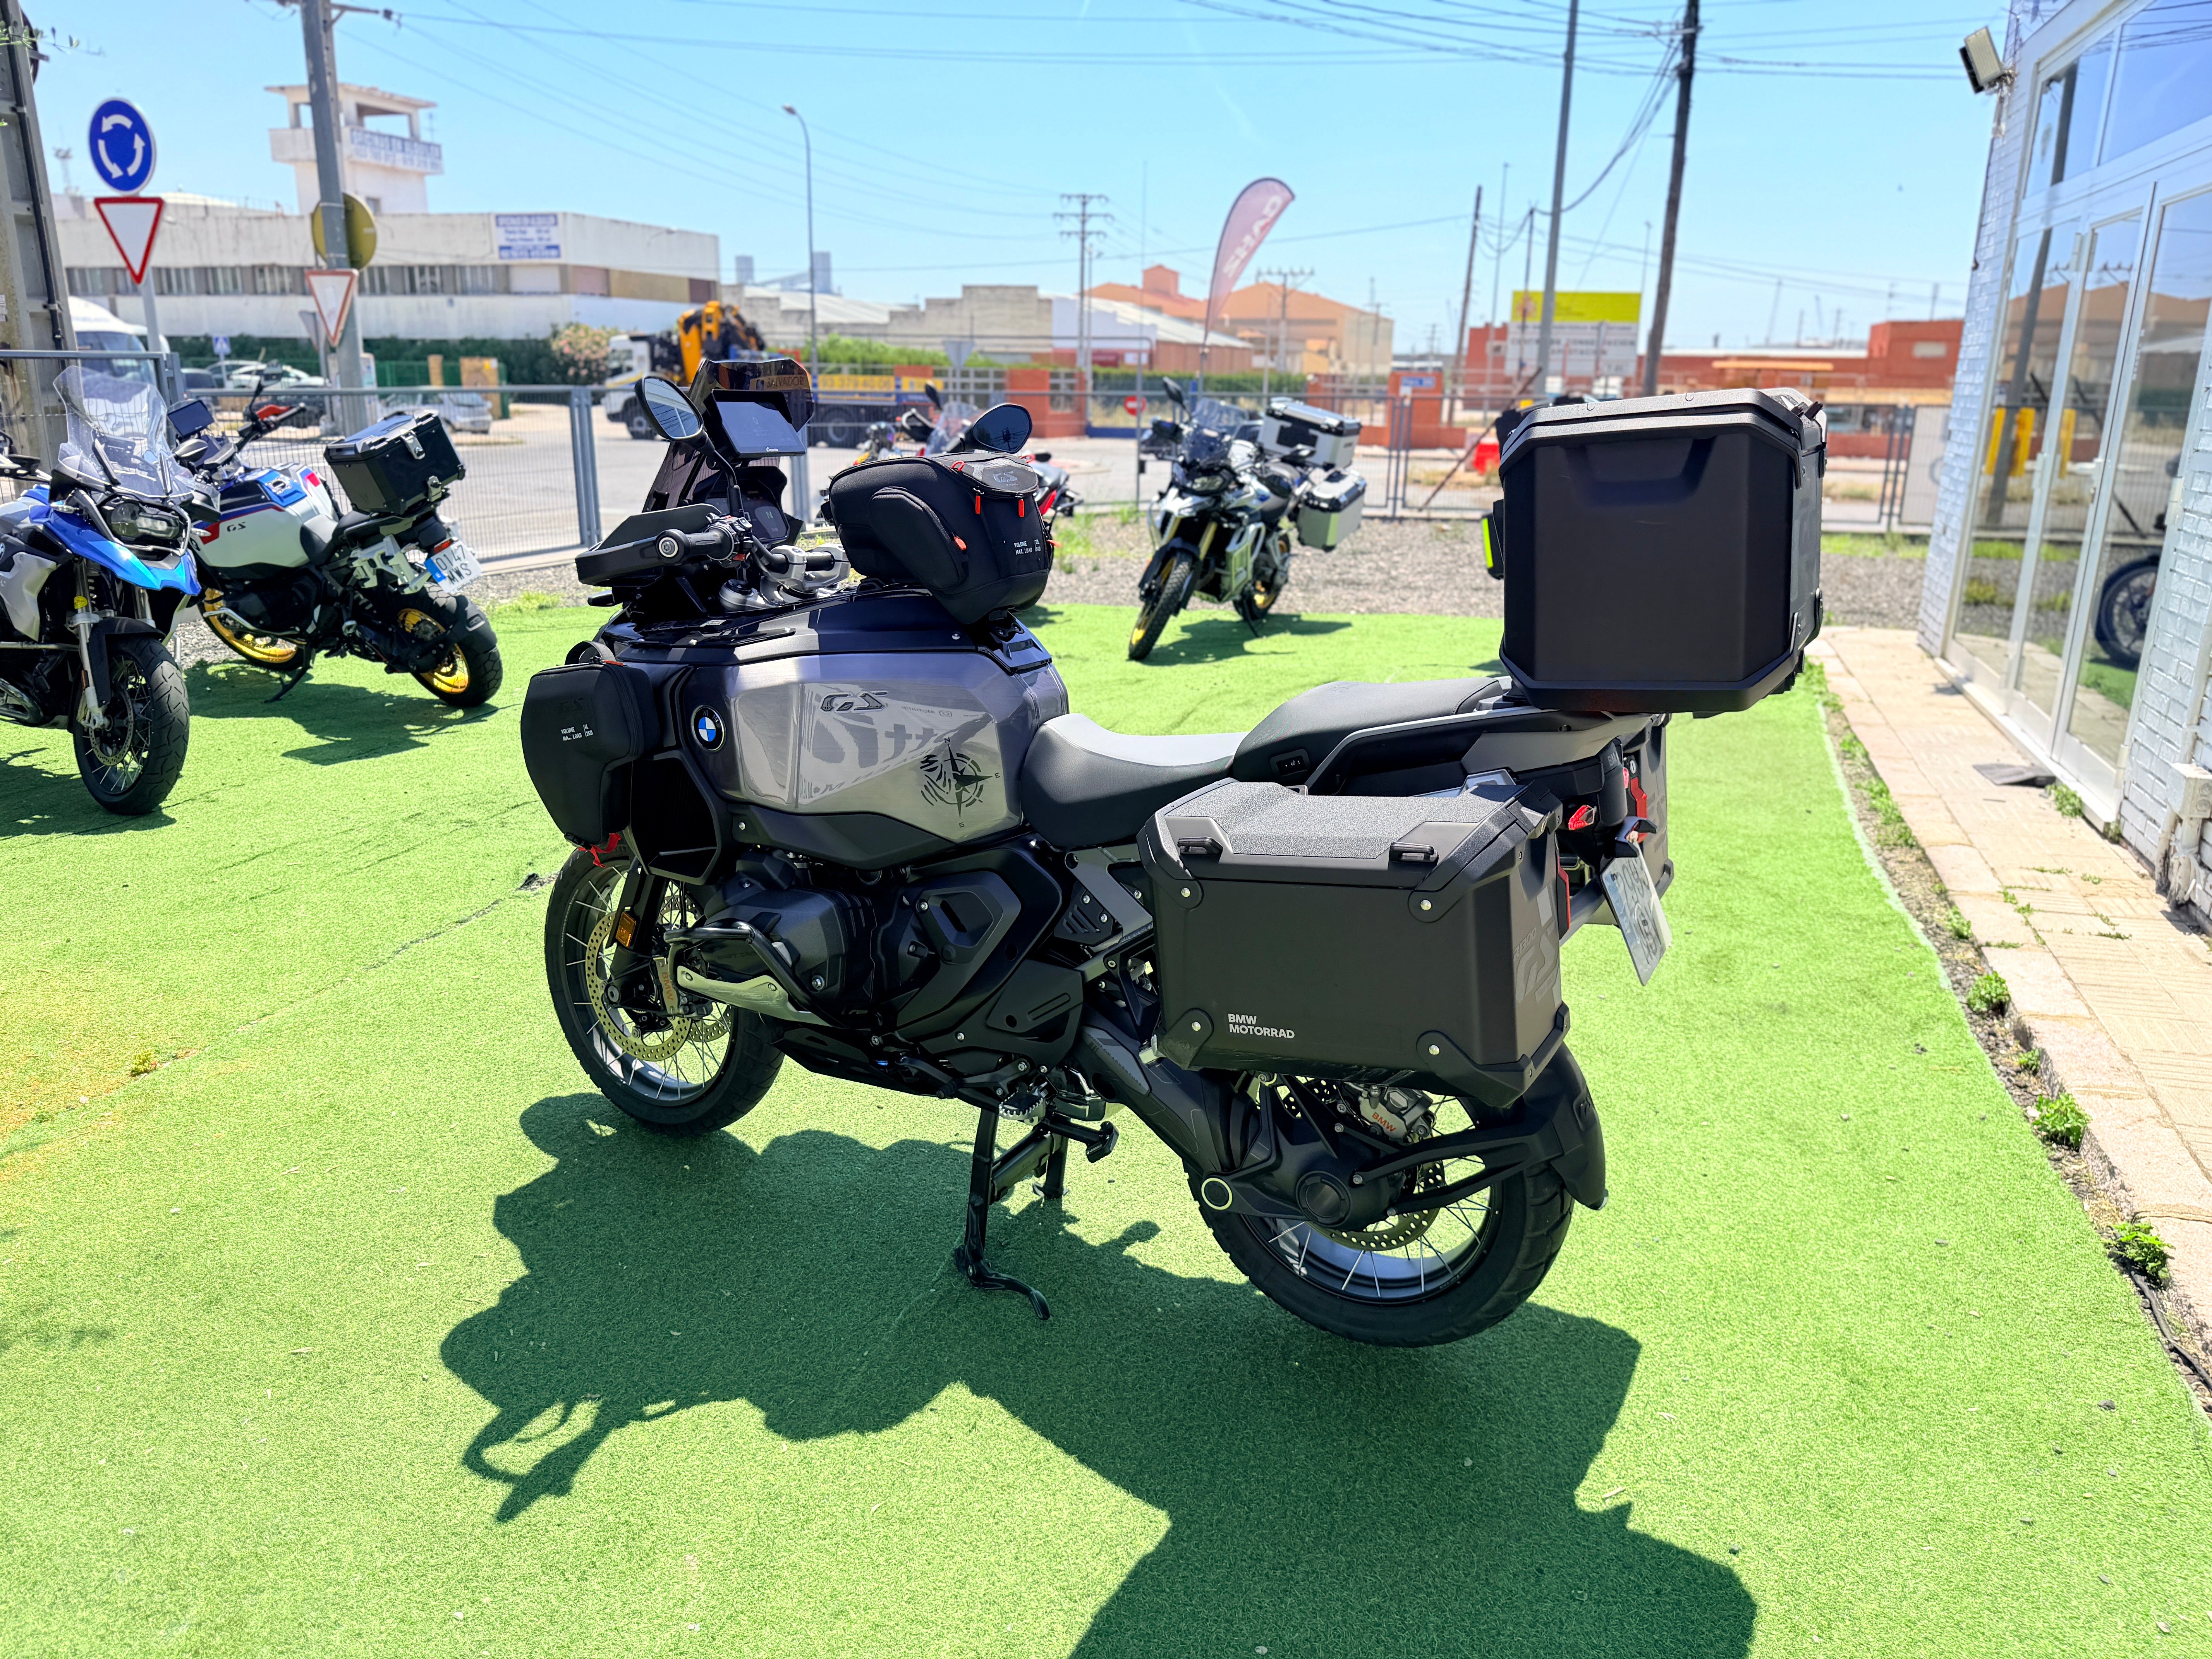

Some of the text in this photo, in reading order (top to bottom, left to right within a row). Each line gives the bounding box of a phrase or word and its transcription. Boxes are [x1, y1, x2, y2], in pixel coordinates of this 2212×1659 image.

[766, 511, 773, 519] N
[227, 521, 246, 532] GS
[435, 544, 465, 570] 0147
[448, 562, 471, 585] MWS
[819, 690, 889, 713] GS
[561, 726, 575, 735] VOLUME
[662, 972, 674, 1001] BMW
[1228, 1013, 1257, 1024] BMW
[1229, 1024, 1295, 1038] MOTORRAD
[1372, 1112, 1396, 1132] BMW
